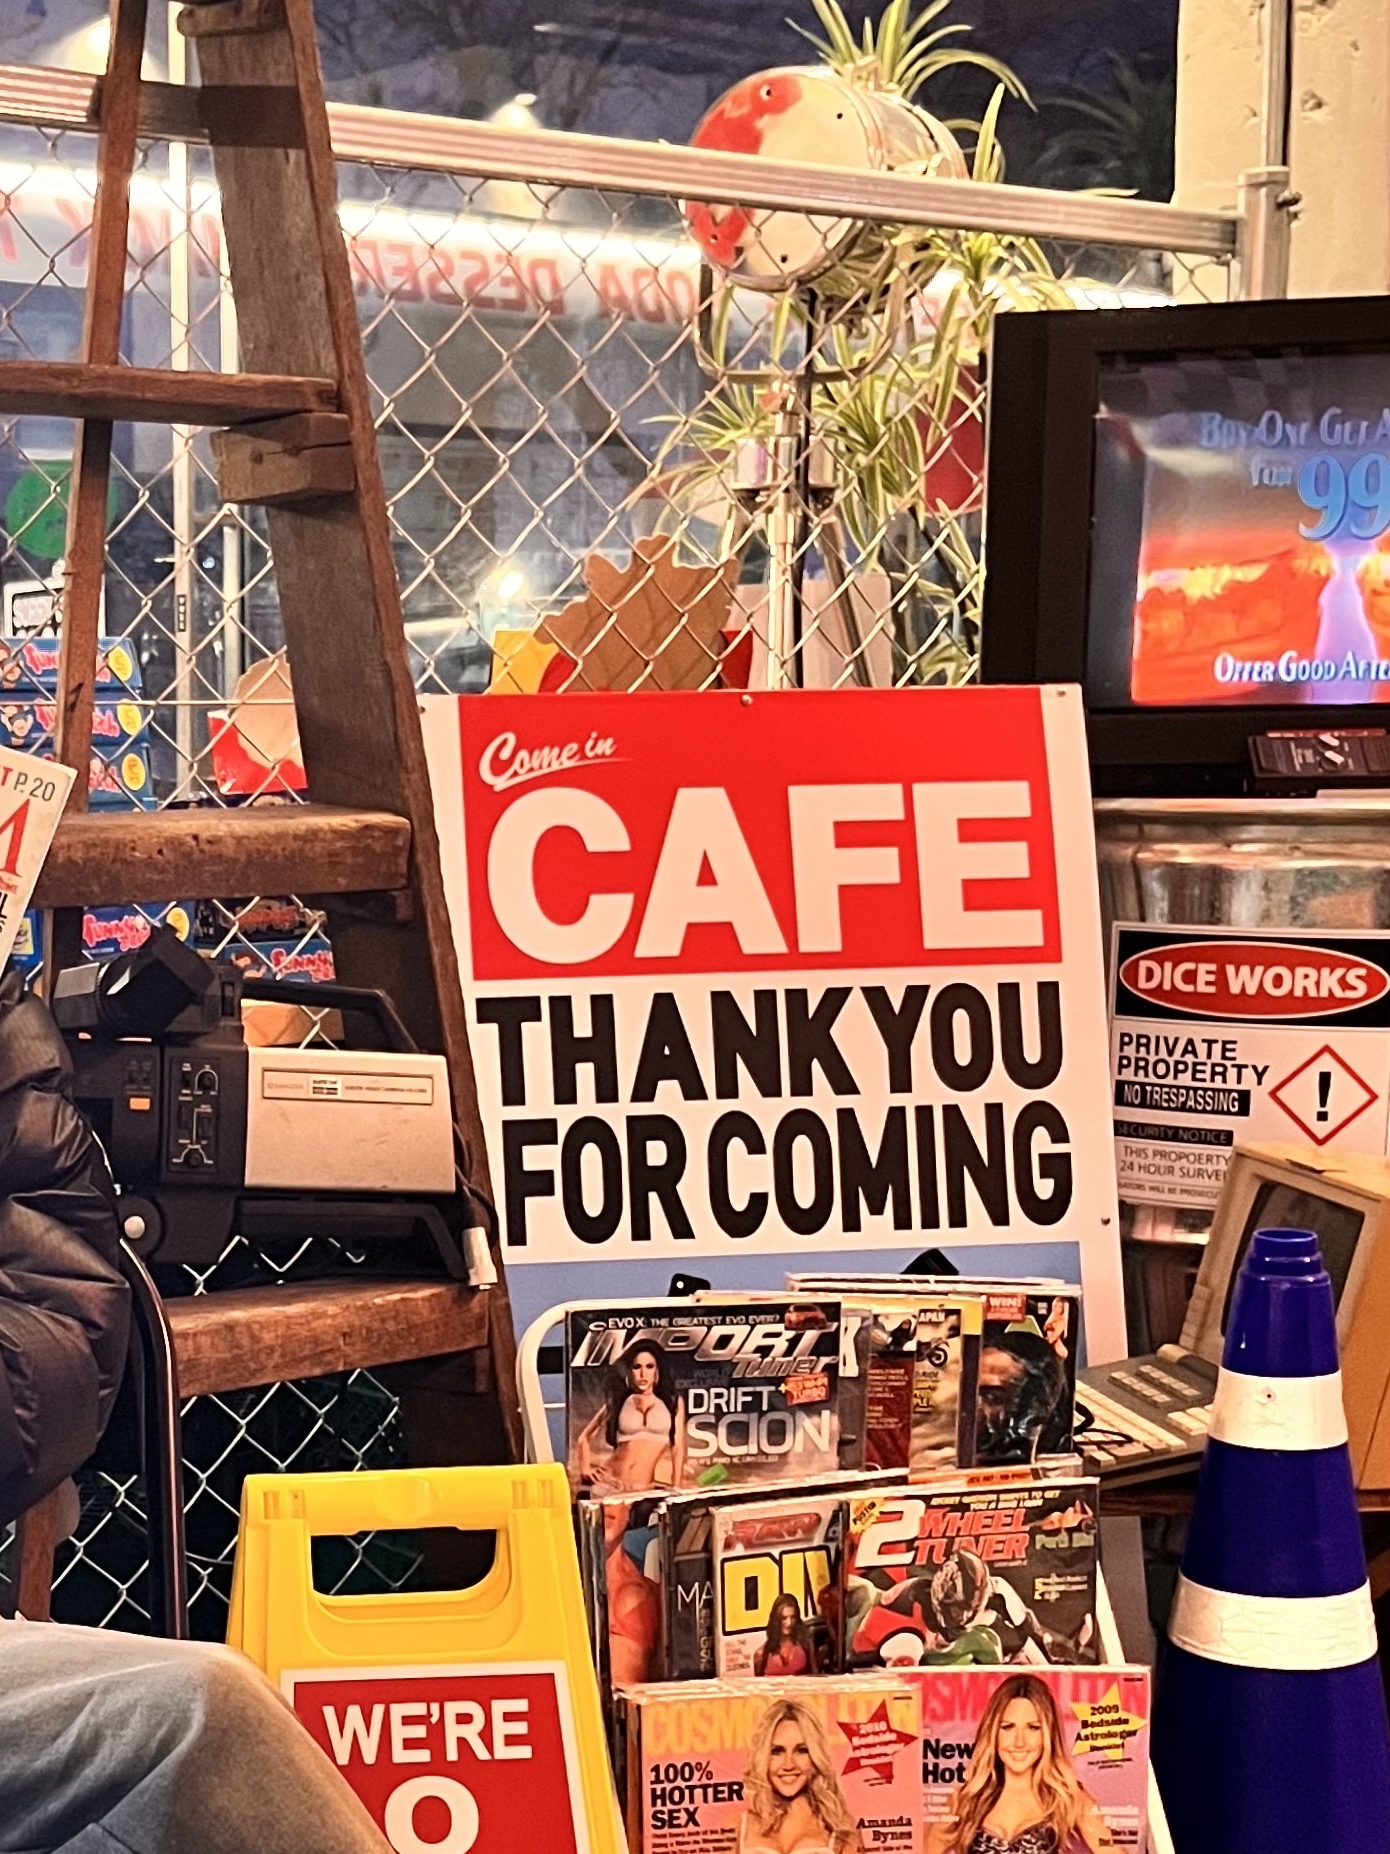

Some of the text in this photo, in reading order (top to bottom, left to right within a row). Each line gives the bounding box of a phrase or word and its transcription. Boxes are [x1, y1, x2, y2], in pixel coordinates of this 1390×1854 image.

[478, 731, 617, 792] Come in
[31, 777, 56, 802] 20
[486, 780, 1045, 964] CAFE
[1137, 959, 1368, 999] DICE WORKS
[476, 981, 1064, 1107] THANK YOU
[1119, 1032, 1238, 1061] PRIVATE
[1117, 1055, 1270, 1086] PROPERTY
[1123, 1084, 1239, 1113] NO TRESPASSING
[1117, 1122, 1228, 1144] SECURITY NOTICE
[1123, 1145, 1149, 1160] THIS
[502, 1100, 1073, 1247] FOR COMING
[1119, 1159, 1134, 1172] 24
[1138, 1162, 1175, 1177] HOUR
[608, 1314, 781, 1329] EVO THE GREATEST EVO EVER?
[688, 1386, 776, 1414] DRIFT
[686, 1410, 831, 1457] SCION
[855, 1499, 927, 1568] 2
[919, 1508, 1031, 1538] WHEEL
[1081, 1716, 1130, 1730] Bedside
[1090, 1704, 1120, 1717] 2009
[324, 1699, 533, 1765] WE'RE
[923, 1738, 976, 1760] New
[650, 1761, 714, 1786] 100%
[923, 1762, 966, 1784] Hot
[651, 1781, 745, 1808] HOTTER
[651, 1807, 701, 1830] SEX
[857, 1816, 913, 1829] Amanda
[872, 1829, 913, 1844] Bynes
